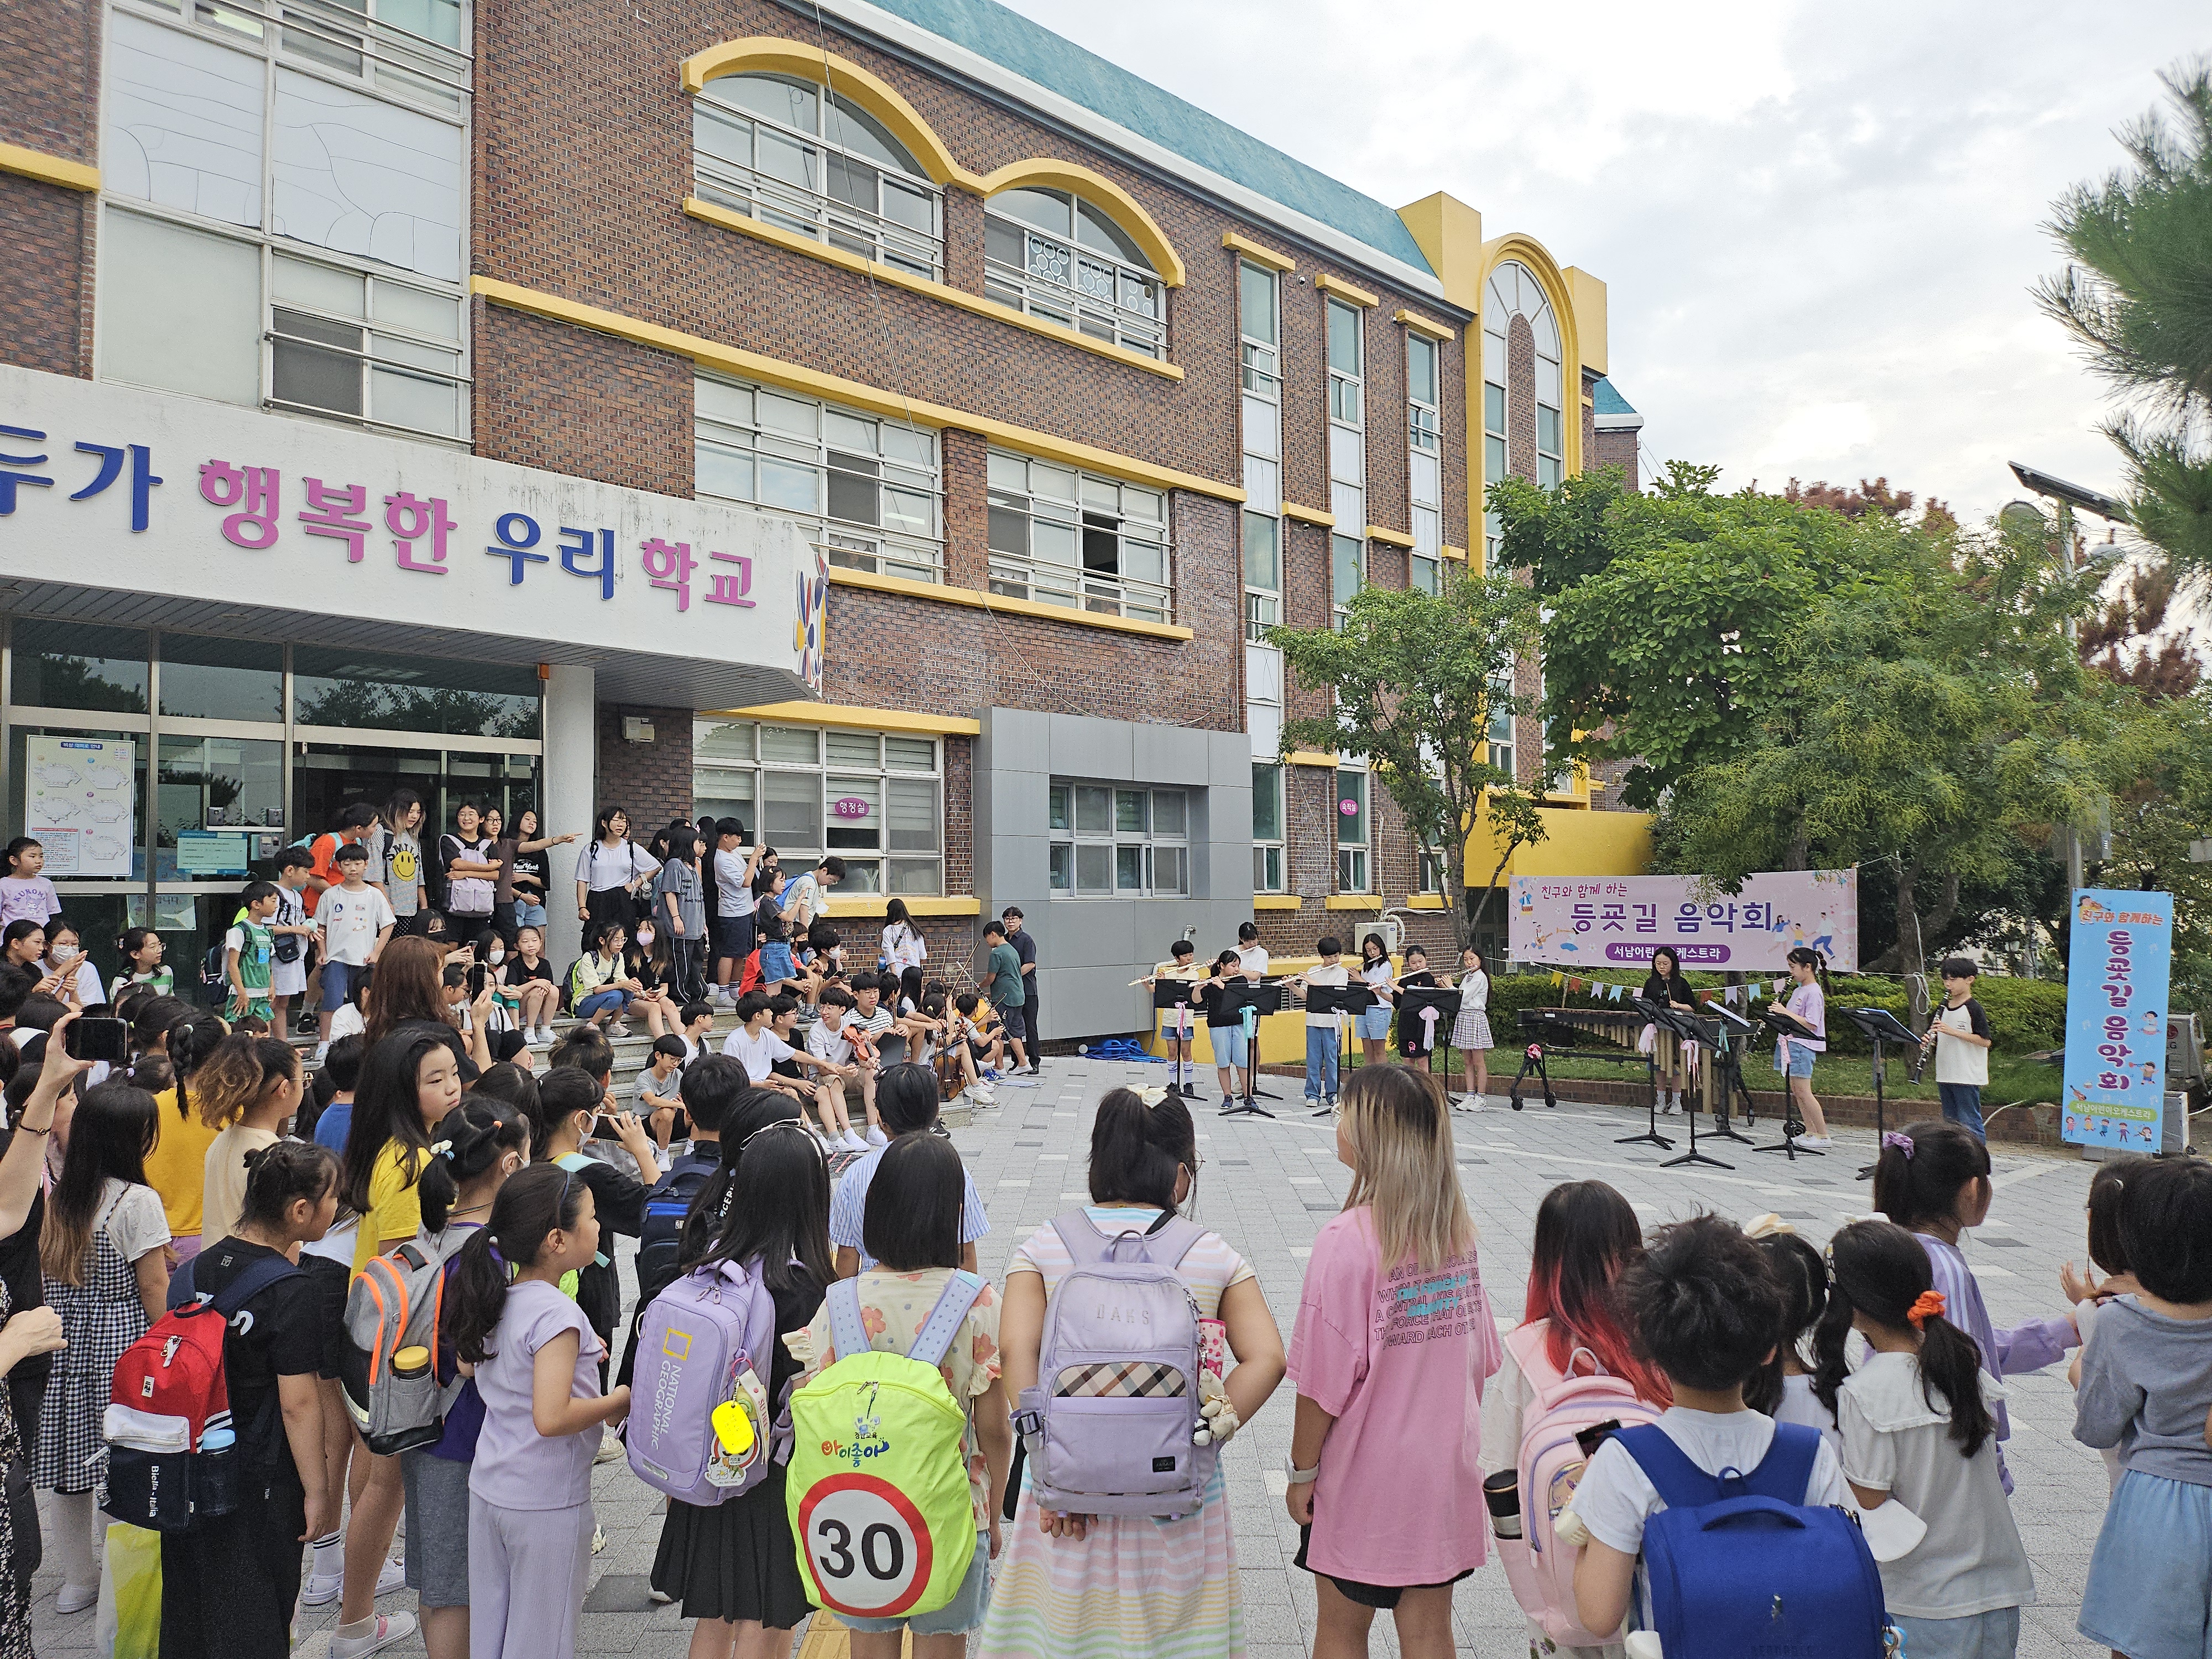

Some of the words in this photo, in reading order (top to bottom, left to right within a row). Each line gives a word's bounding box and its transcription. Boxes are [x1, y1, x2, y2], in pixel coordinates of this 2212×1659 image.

[199, 459, 458, 575] 행복한
[485, 512, 615, 601] 우리
[639, 537, 758, 612] 학교
[839, 801, 865, 813] 행정실
[1342, 802, 1357, 812] 숙직실
[1541, 885, 1573, 900] 친구와
[1578, 883, 1601, 899] 함께
[1606, 882, 1627, 897] 하는
[1571, 903, 1657, 933] 등굣길
[1674, 901, 1771, 933] 음악회
[2083, 909, 2115, 923] 친구와
[1614, 946, 1721, 960] 서남어린케스트라
[2101, 930, 2133, 1008] 등굣길
[2098, 1015, 2132, 1090] 음악회
[1097, 1304, 1149, 1325] DAKS
[651, 1360, 671, 1450] GEOGRAPHIC
[660, 1365, 682, 1434] NATIONAL
[821, 1438, 890, 1467] 아이좋아
[151, 1465, 159, 1490] Biella
[818, 1519, 905, 1580] 30
